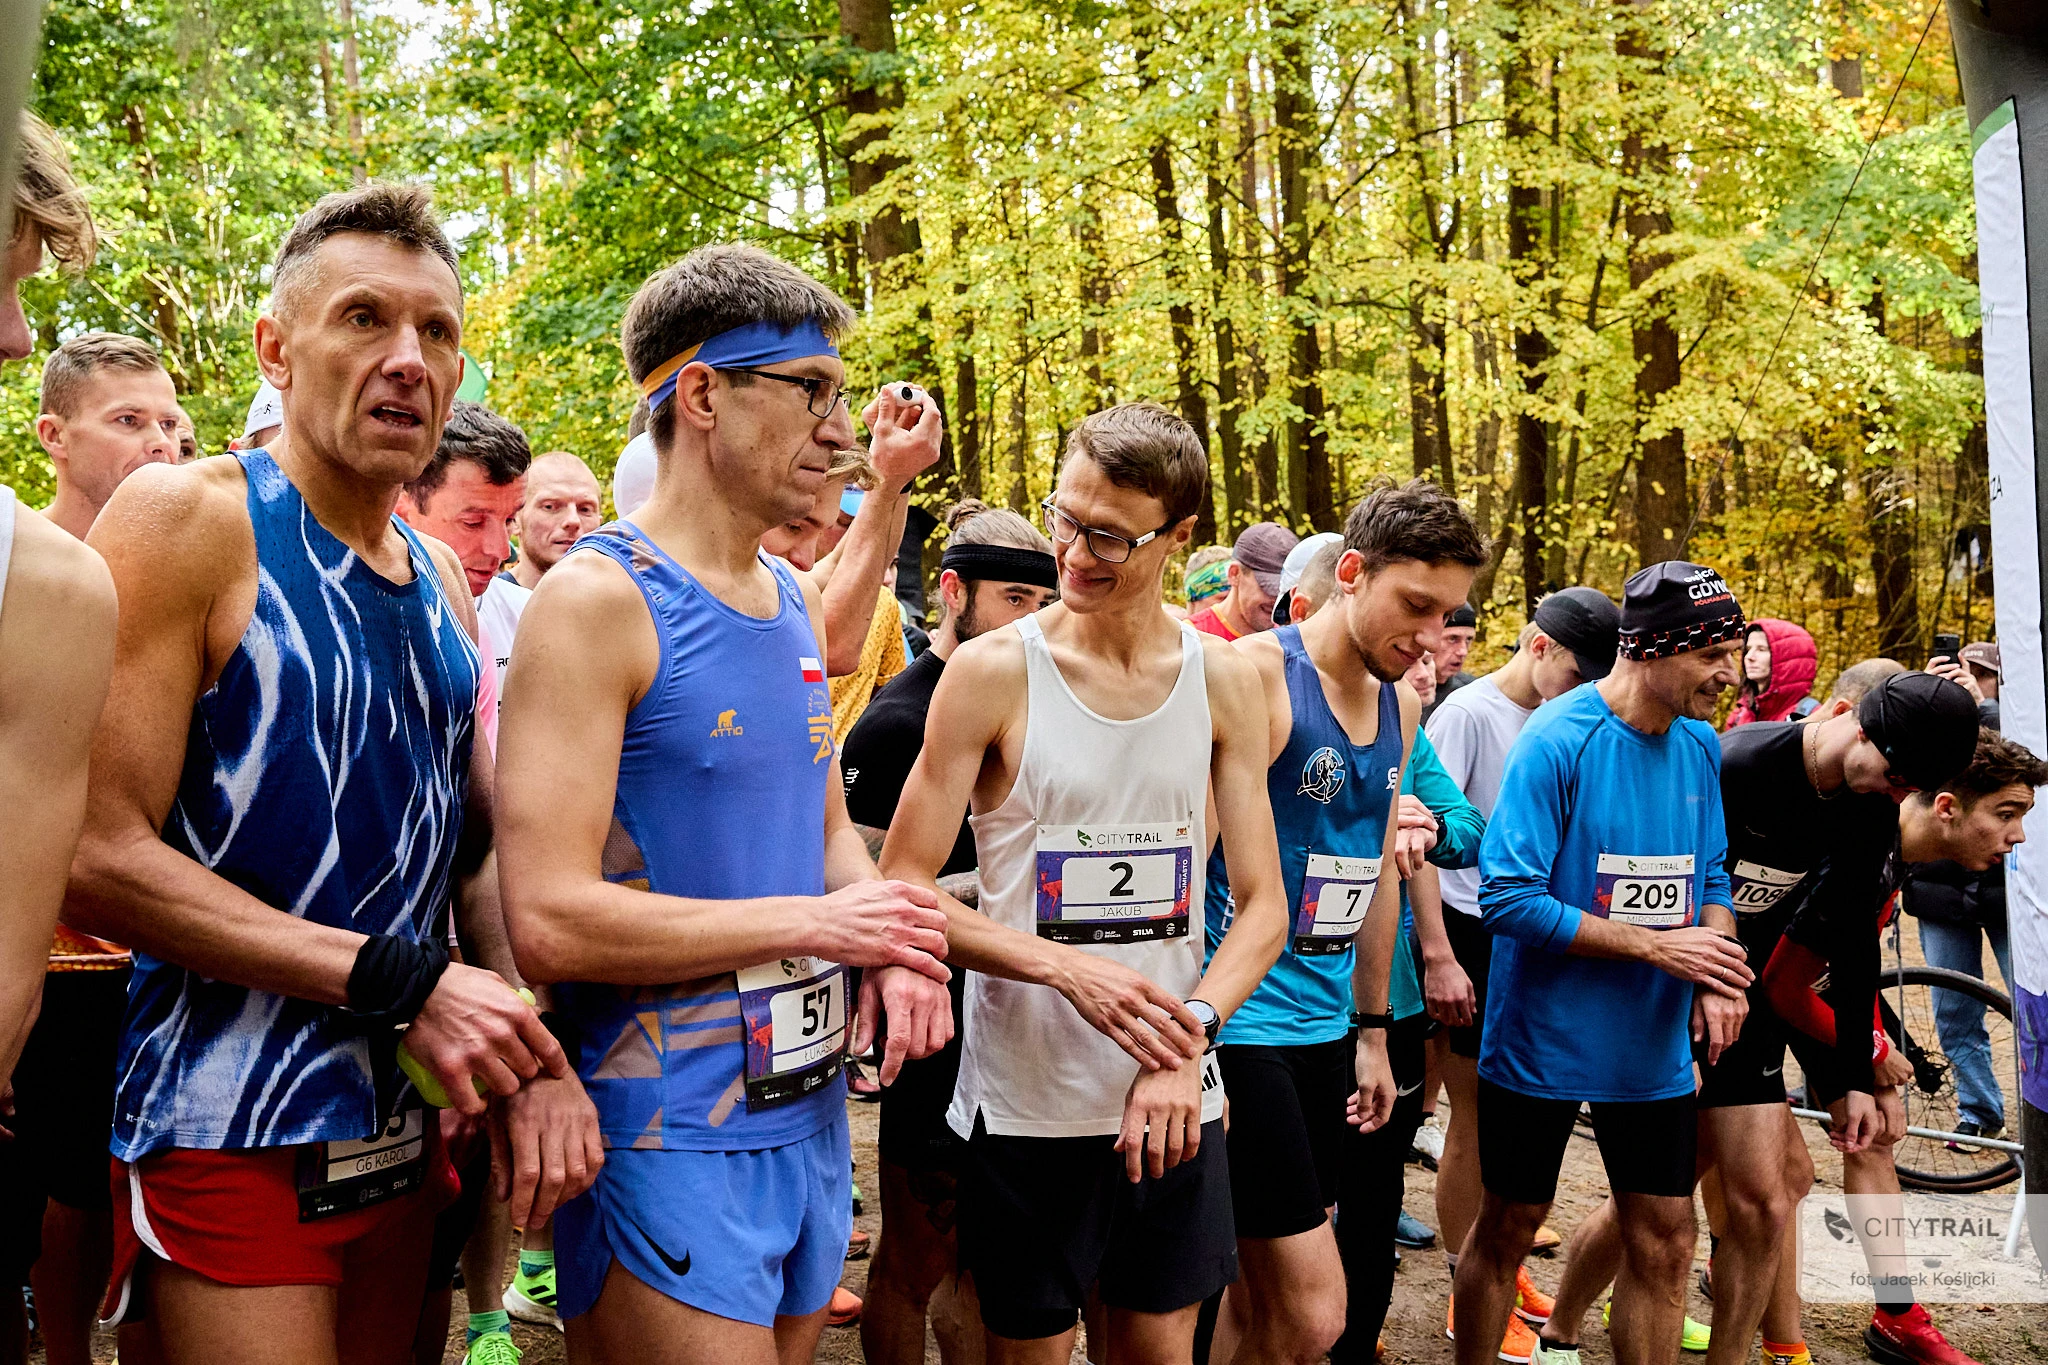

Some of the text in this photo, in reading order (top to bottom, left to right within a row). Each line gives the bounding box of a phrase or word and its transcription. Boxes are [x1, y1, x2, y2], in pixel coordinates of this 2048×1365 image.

[1108, 861, 1135, 897] 2
[1345, 888, 1362, 918] 7
[1623, 883, 1678, 910] 209
[1738, 884, 1788, 904] 108
[1099, 906, 1143, 918] JAKUB
[1132, 928, 1154, 937] SILVA
[801, 984, 831, 1037] 57
[356, 1146, 409, 1173] G6 KAROL
